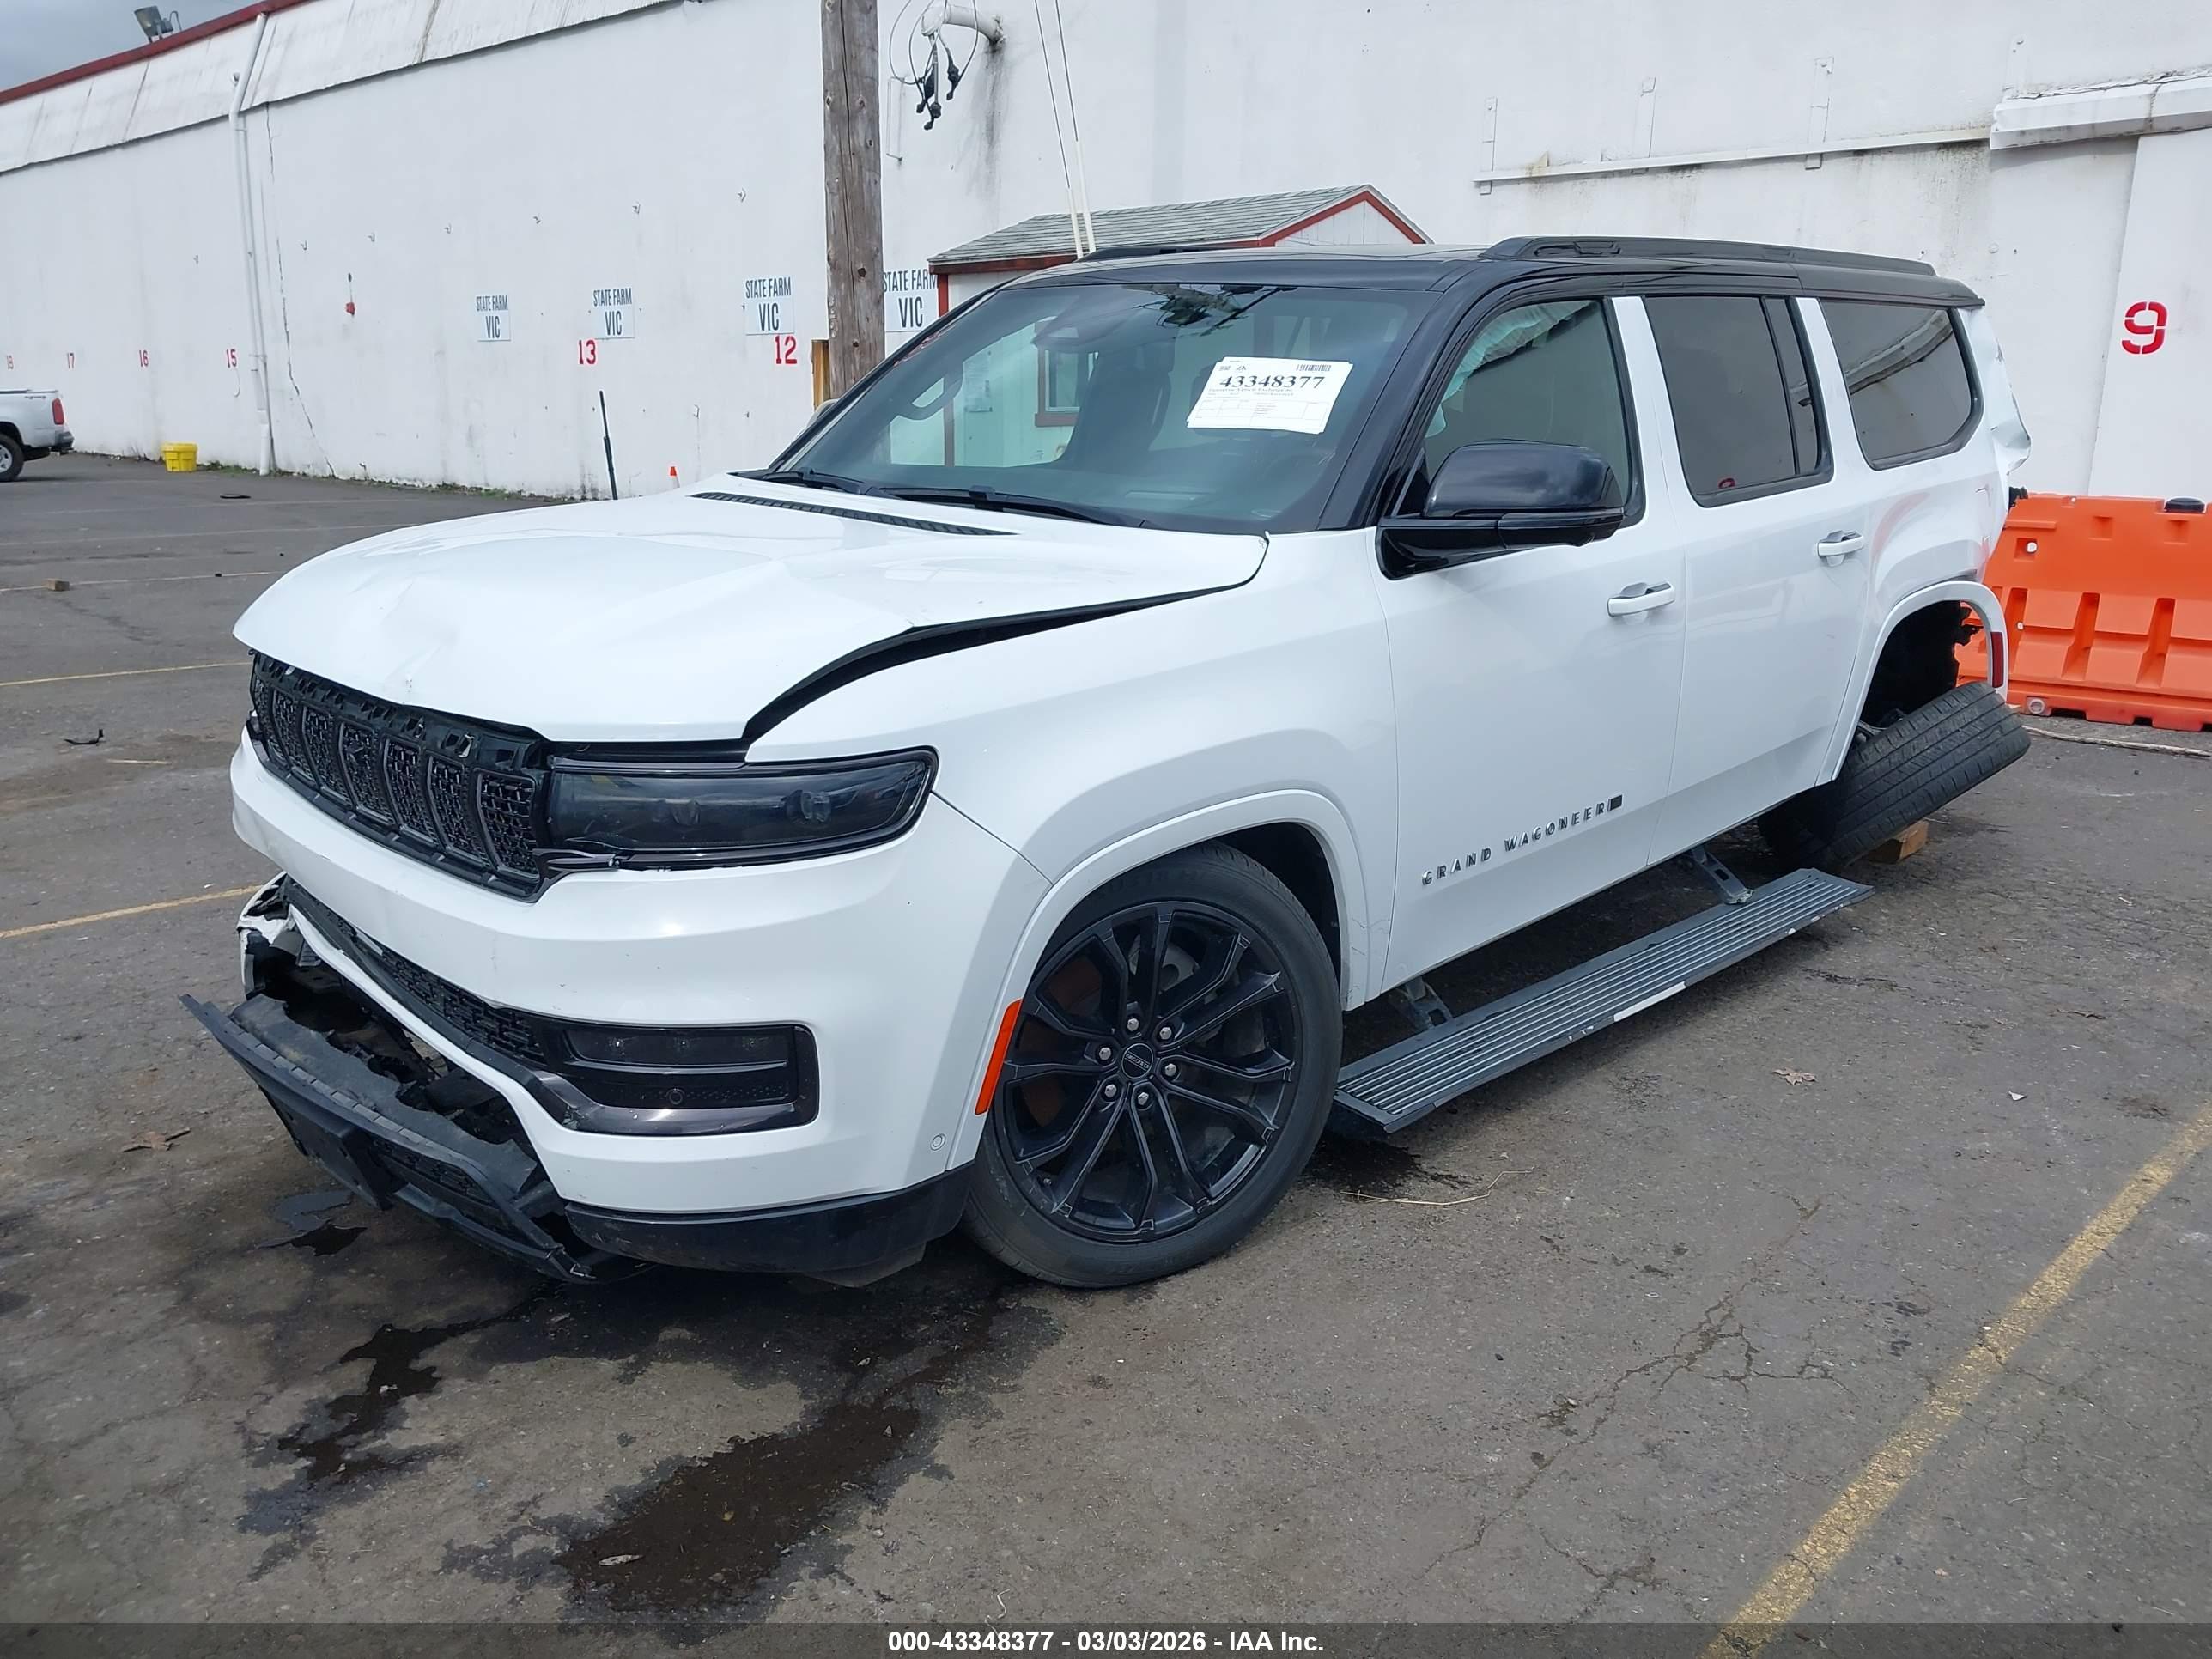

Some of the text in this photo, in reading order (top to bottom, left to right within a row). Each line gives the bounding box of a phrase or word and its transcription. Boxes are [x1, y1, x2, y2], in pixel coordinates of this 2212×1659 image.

[745, 276, 791, 298] STATE FARM
[883, 270, 908, 292] STATE
[476, 295, 508, 311] STATE FARM
[593, 288, 632, 307] STATE FARM
[605, 310, 622, 336] VIC
[758, 302, 779, 331] VIC
[898, 296, 923, 328] VIC
[485, 315, 501, 339] VIC
[2121, 301, 2167, 355] 9
[67, 352, 75, 369] 17
[139, 349, 149, 368] 16
[226, 349, 237, 368] 15
[578, 339, 596, 364] 13
[775, 335, 797, 364] 12
[1219, 375, 1325, 389] 43348377
[1422, 802, 1605, 885] GRAND WAGONEER
